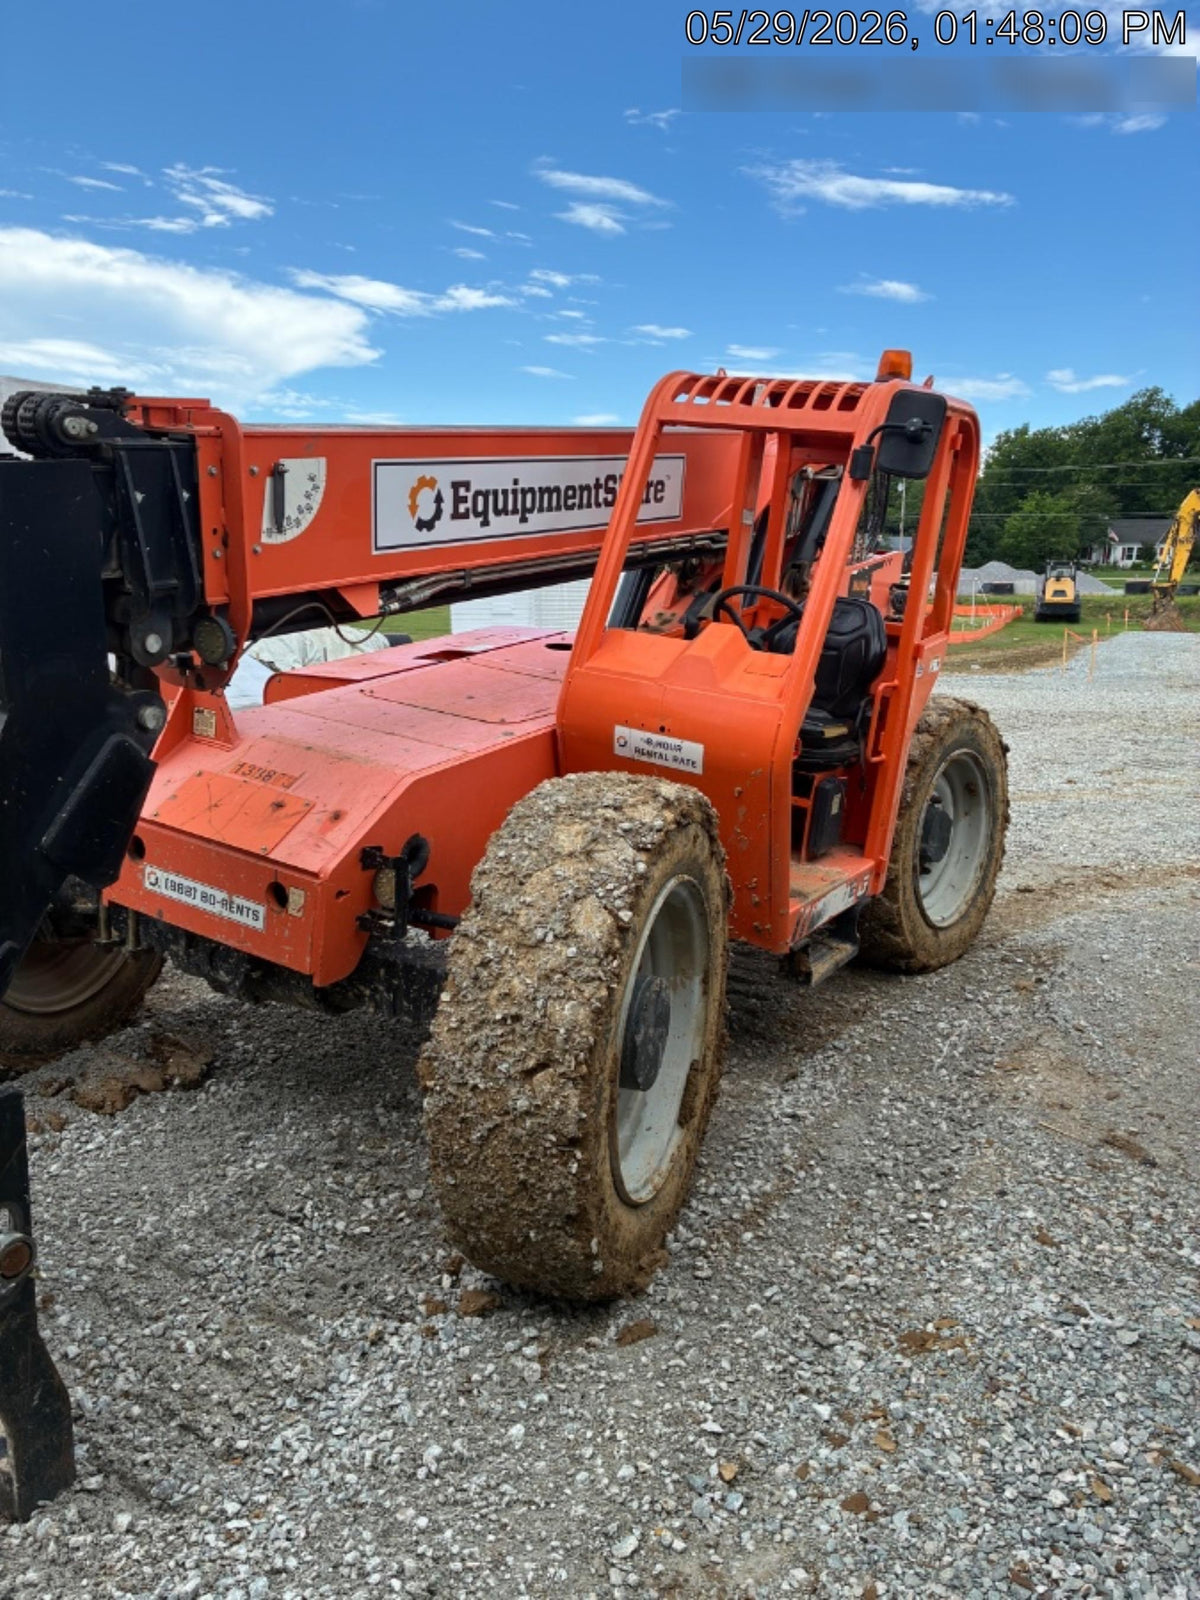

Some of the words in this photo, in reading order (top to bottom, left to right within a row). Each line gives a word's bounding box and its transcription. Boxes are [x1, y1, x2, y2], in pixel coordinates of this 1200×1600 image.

[450, 474, 665, 527] EquipmentSre
[634, 746, 669, 762] RENTAL
[671, 756, 697, 769] RATE
[200, 891, 260, 922] 80-RENTS
